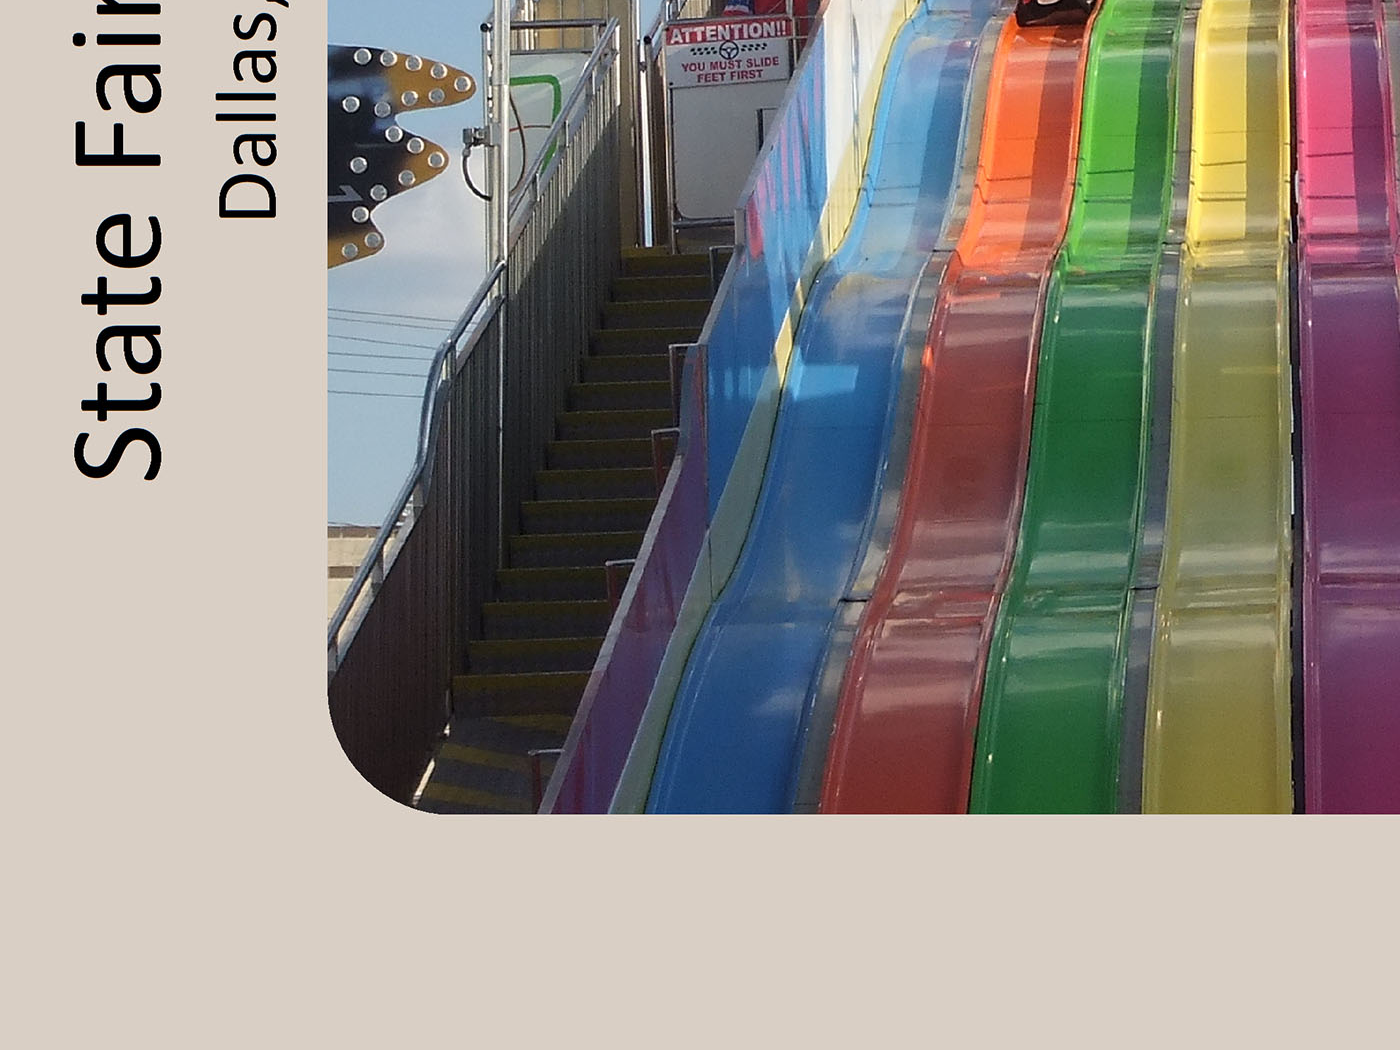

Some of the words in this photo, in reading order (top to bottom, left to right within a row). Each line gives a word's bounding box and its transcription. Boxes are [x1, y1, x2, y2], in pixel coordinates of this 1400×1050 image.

[671, 20, 786, 44] ATTENTION!!
[682, 62, 705, 72] YOU
[710, 60, 742, 70] MUST
[746, 56, 779, 68] SLIDE
[697, 73, 726, 83] FEET
[730, 69, 763, 81] FIRST
